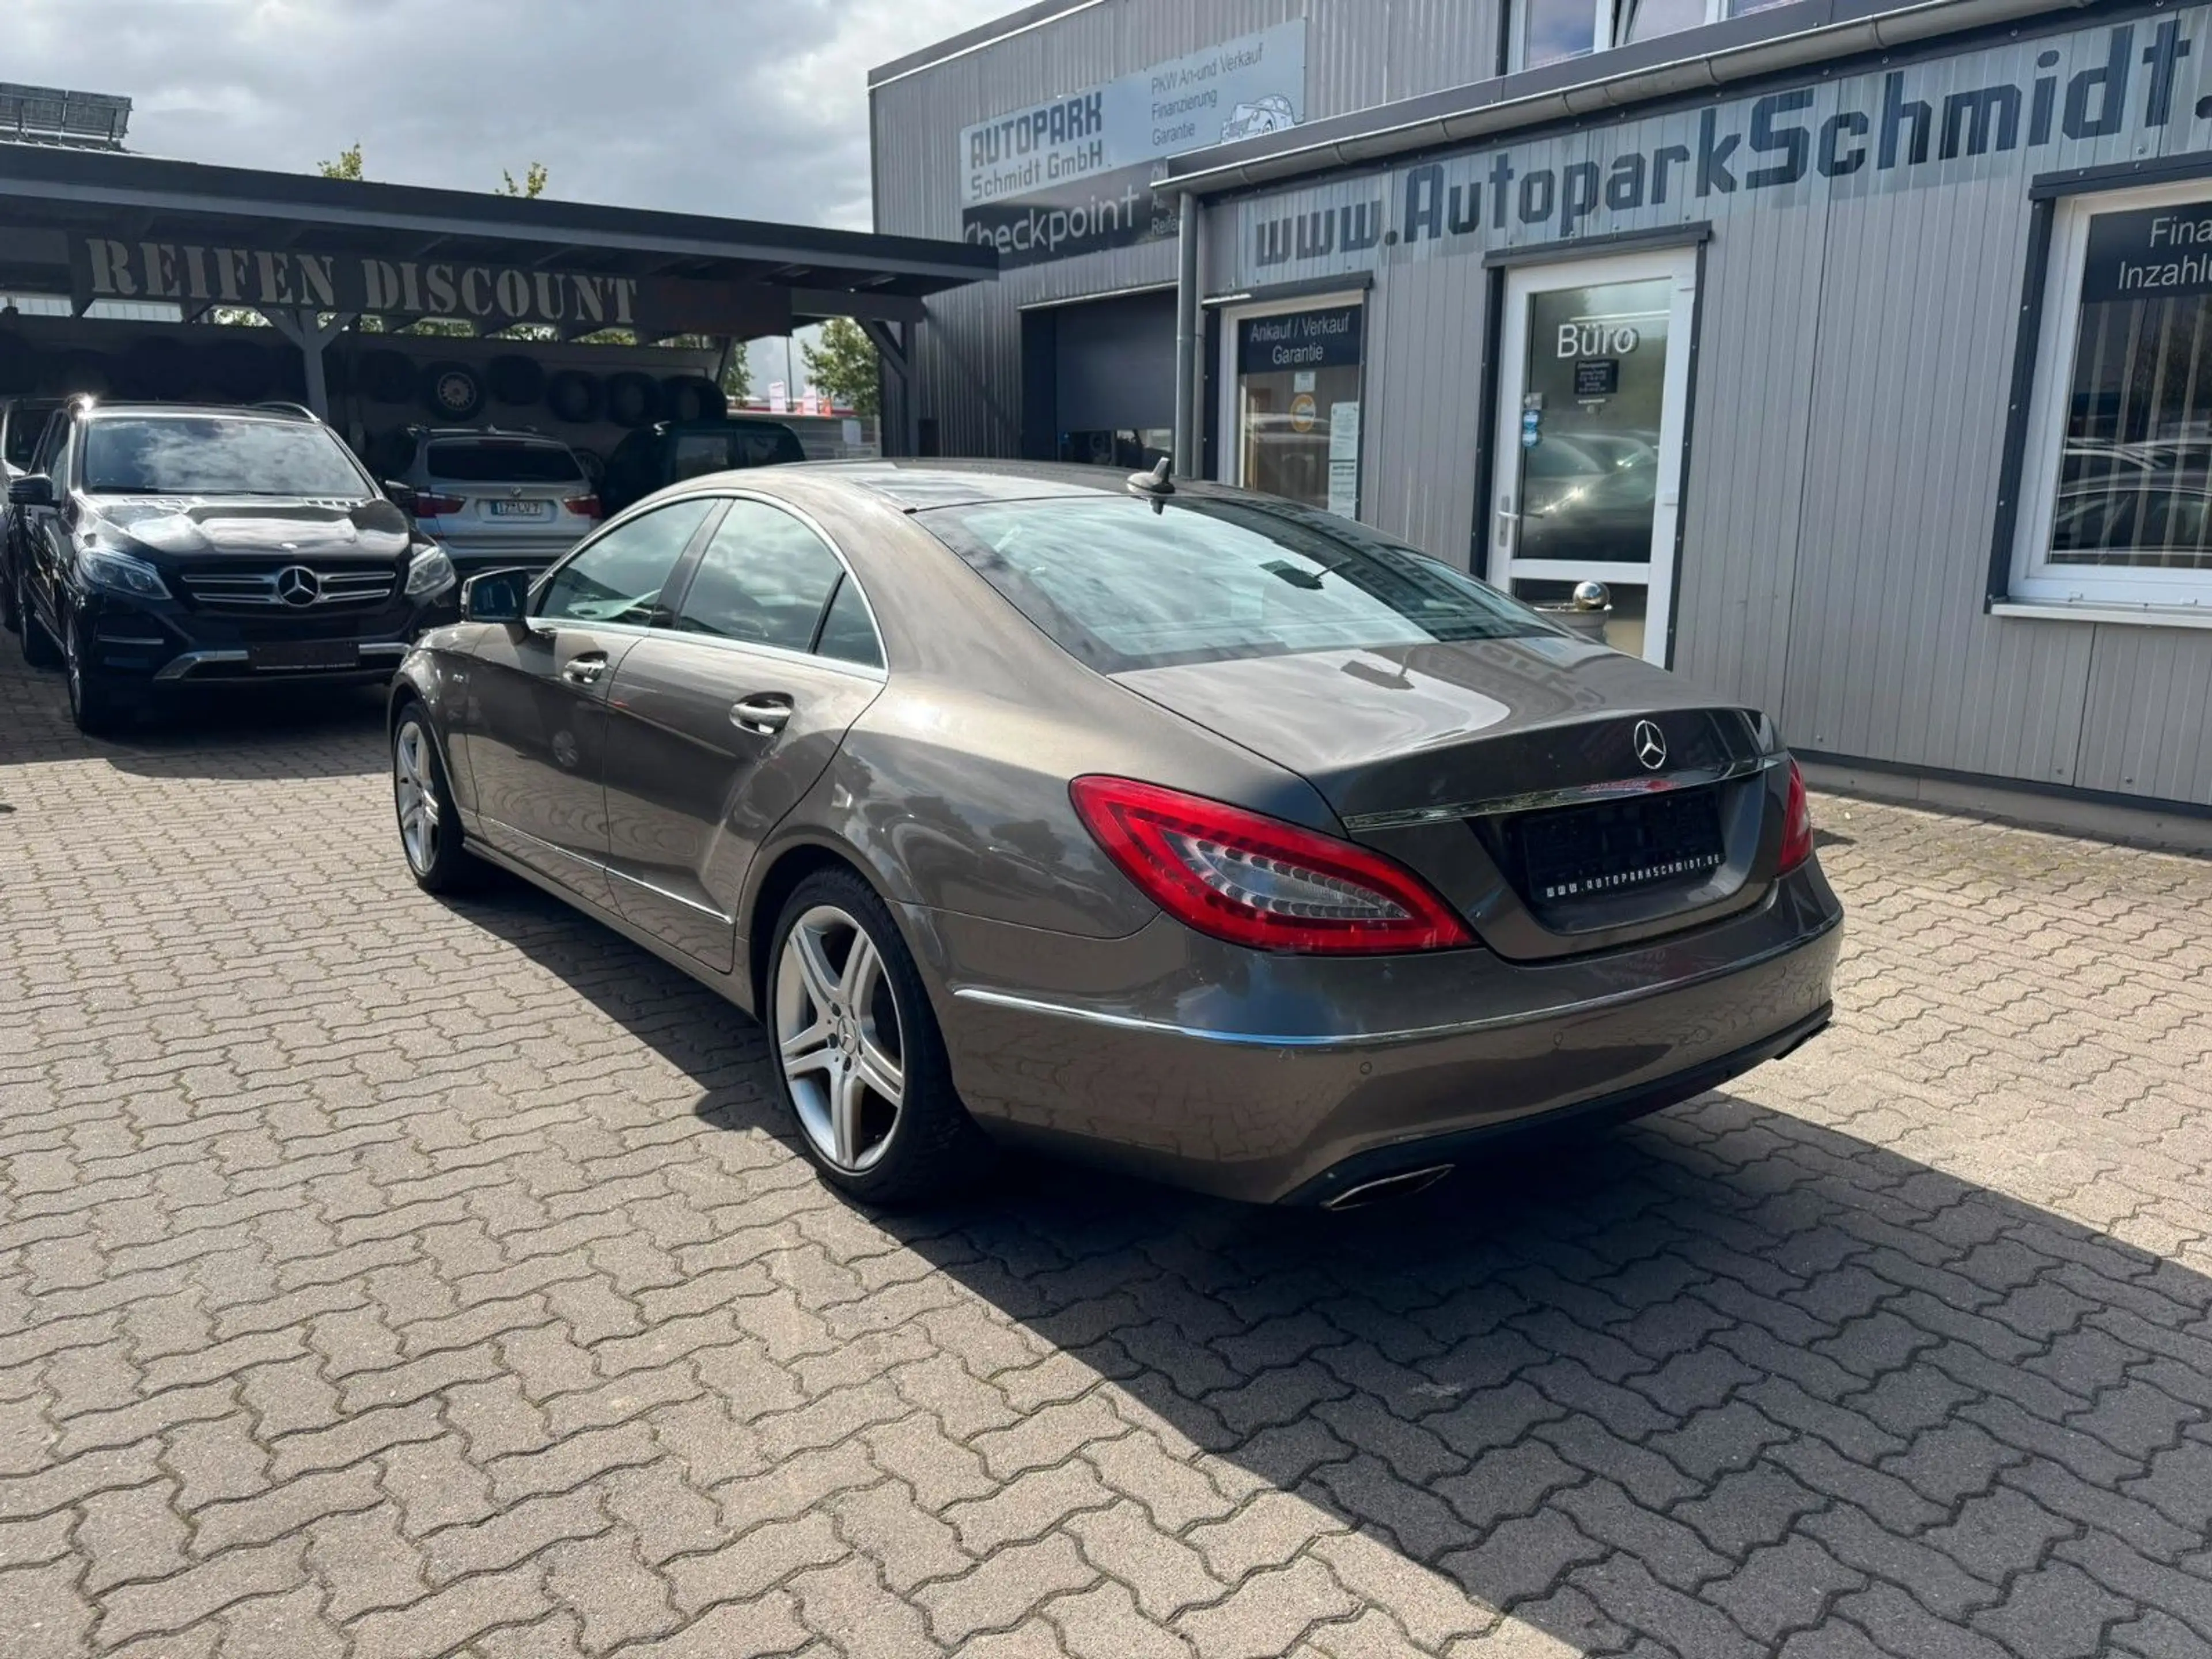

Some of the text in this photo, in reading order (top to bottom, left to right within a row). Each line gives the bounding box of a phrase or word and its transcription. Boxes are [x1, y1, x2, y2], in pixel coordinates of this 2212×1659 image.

[1152, 69, 1177, 95] PKW
[1219, 43, 1263, 73] Verkauf
[1152, 89, 1218, 121] Finanzierung
[971, 92, 1101, 169] AUTOPARK
[1152, 123, 1195, 146] Garantie
[972, 158, 1041, 200] Schmidt
[1047, 139, 1103, 180] GmbH
[2150, 215, 2212, 249] Fina
[85, 238, 637, 324] REIFEN DISCOUNT
[1250, 318, 1292, 342] Ankauf
[1301, 312, 1351, 337] Verkauf
[1557, 323, 1634, 358] Büro
[1272, 342, 1324, 365] Garantie
